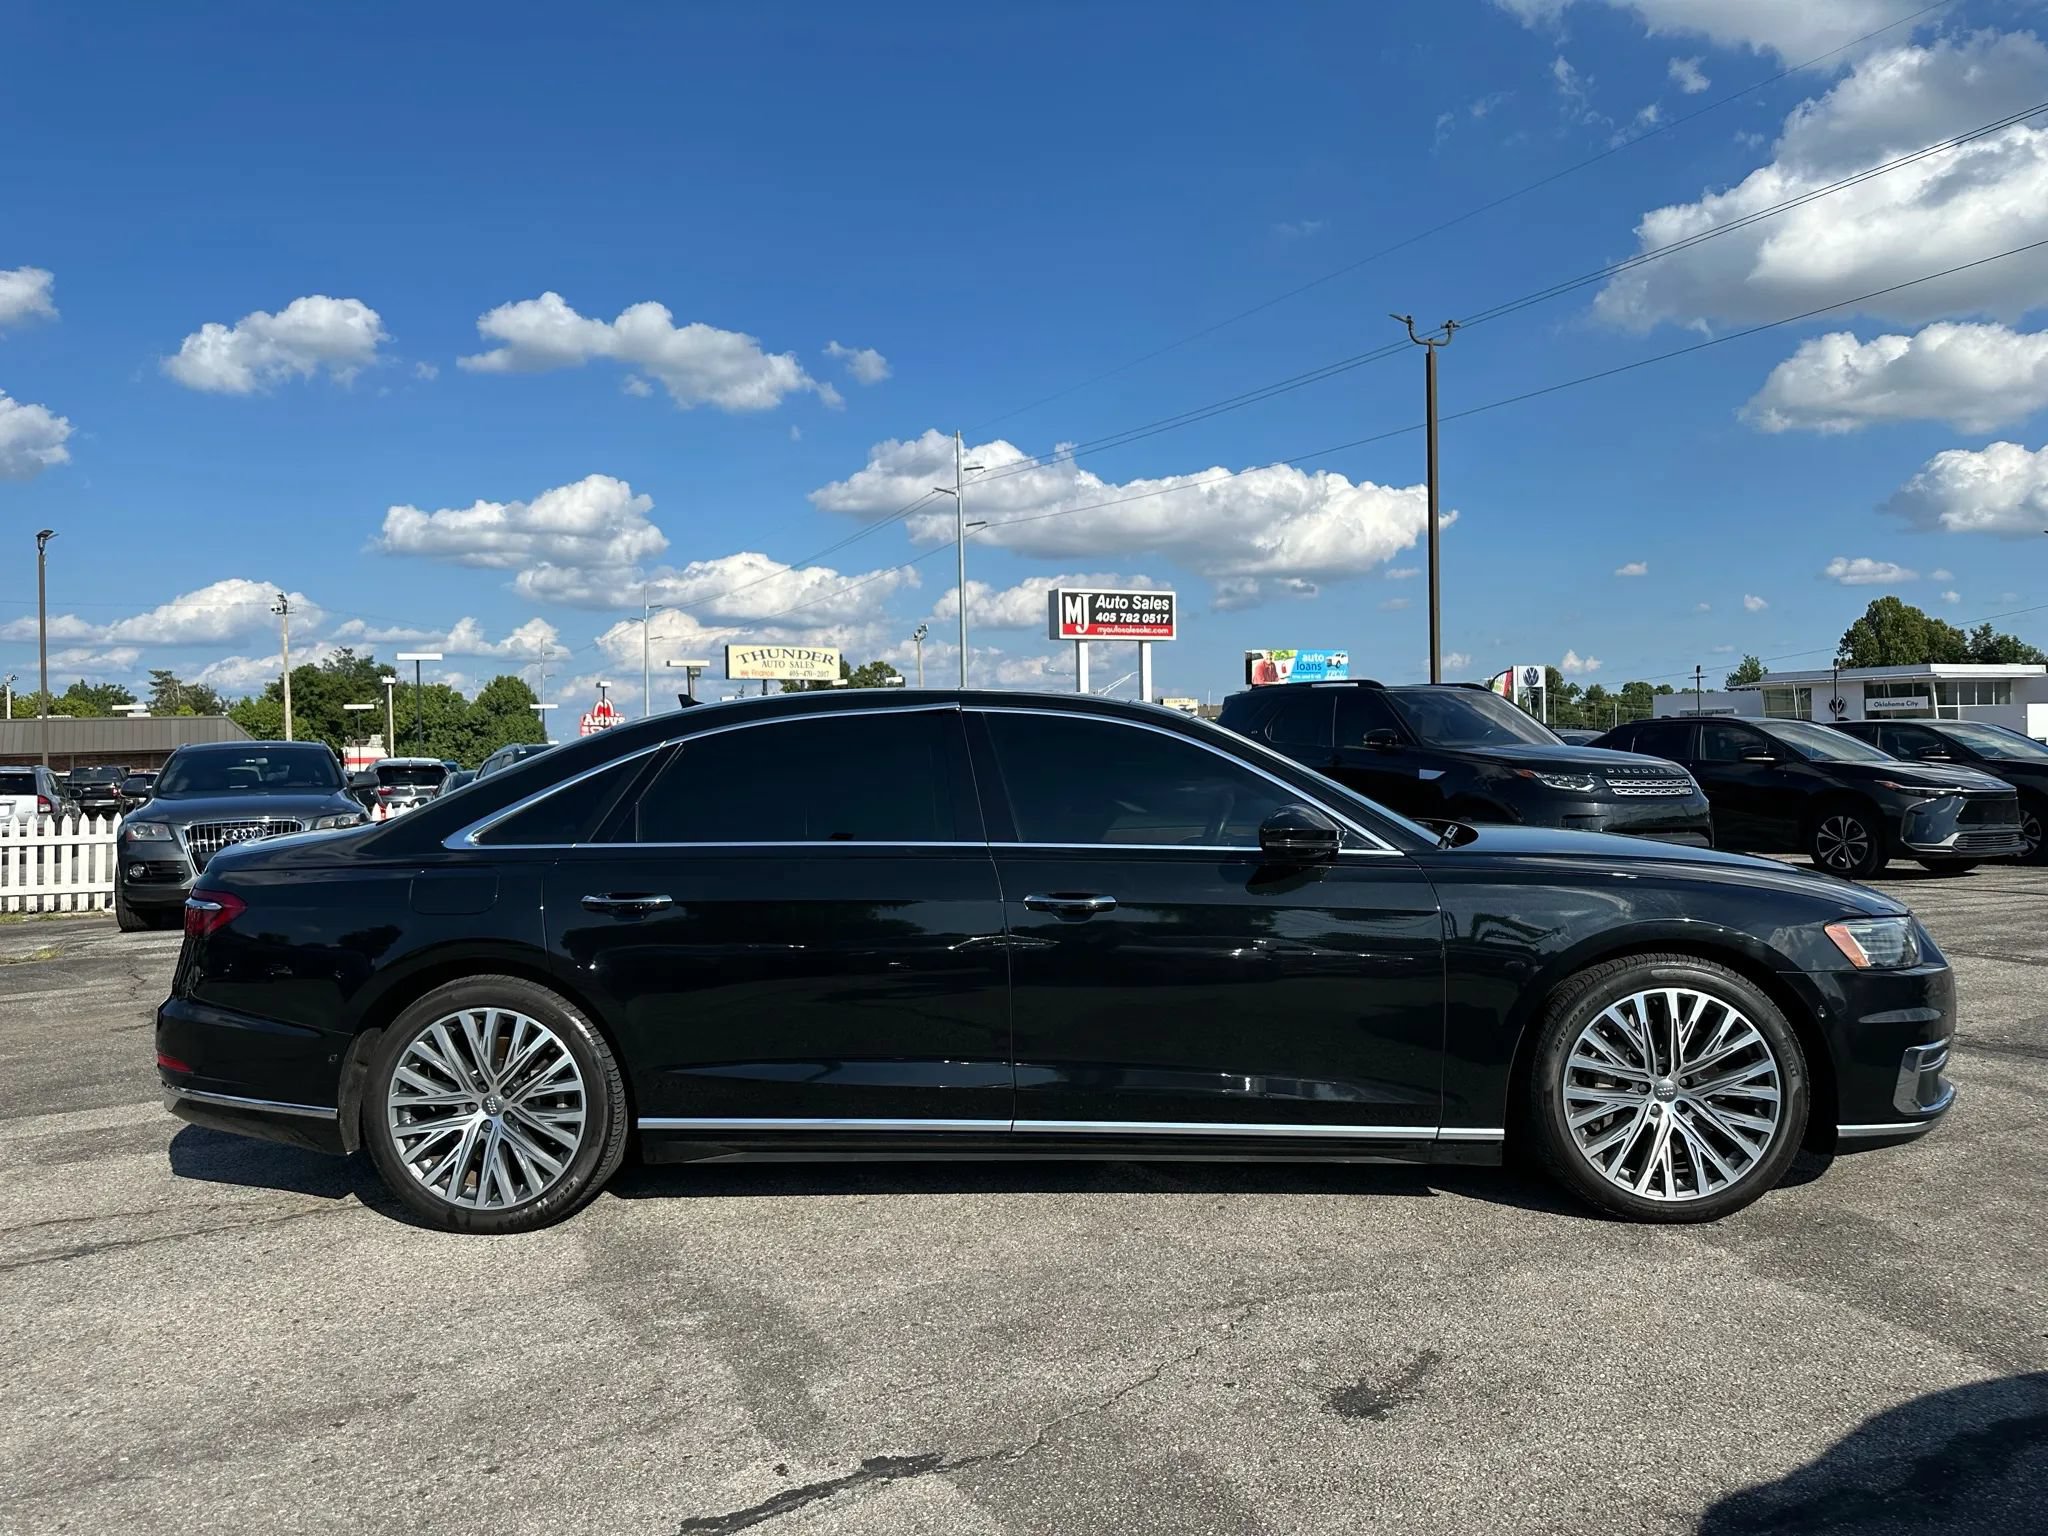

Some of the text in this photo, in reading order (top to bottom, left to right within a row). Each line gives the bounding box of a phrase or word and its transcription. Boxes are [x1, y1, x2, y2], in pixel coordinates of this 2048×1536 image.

[1095, 594, 1169, 610] Auto Sales
[1065, 594, 1092, 633] MJ
[1095, 612, 1169, 624] 405 782 0517
[736, 648, 834, 666] THUNDER
[1302, 653, 1324, 662] auto
[762, 660, 815, 669] AUTO SALES
[1296, 661, 1322, 671] loans
